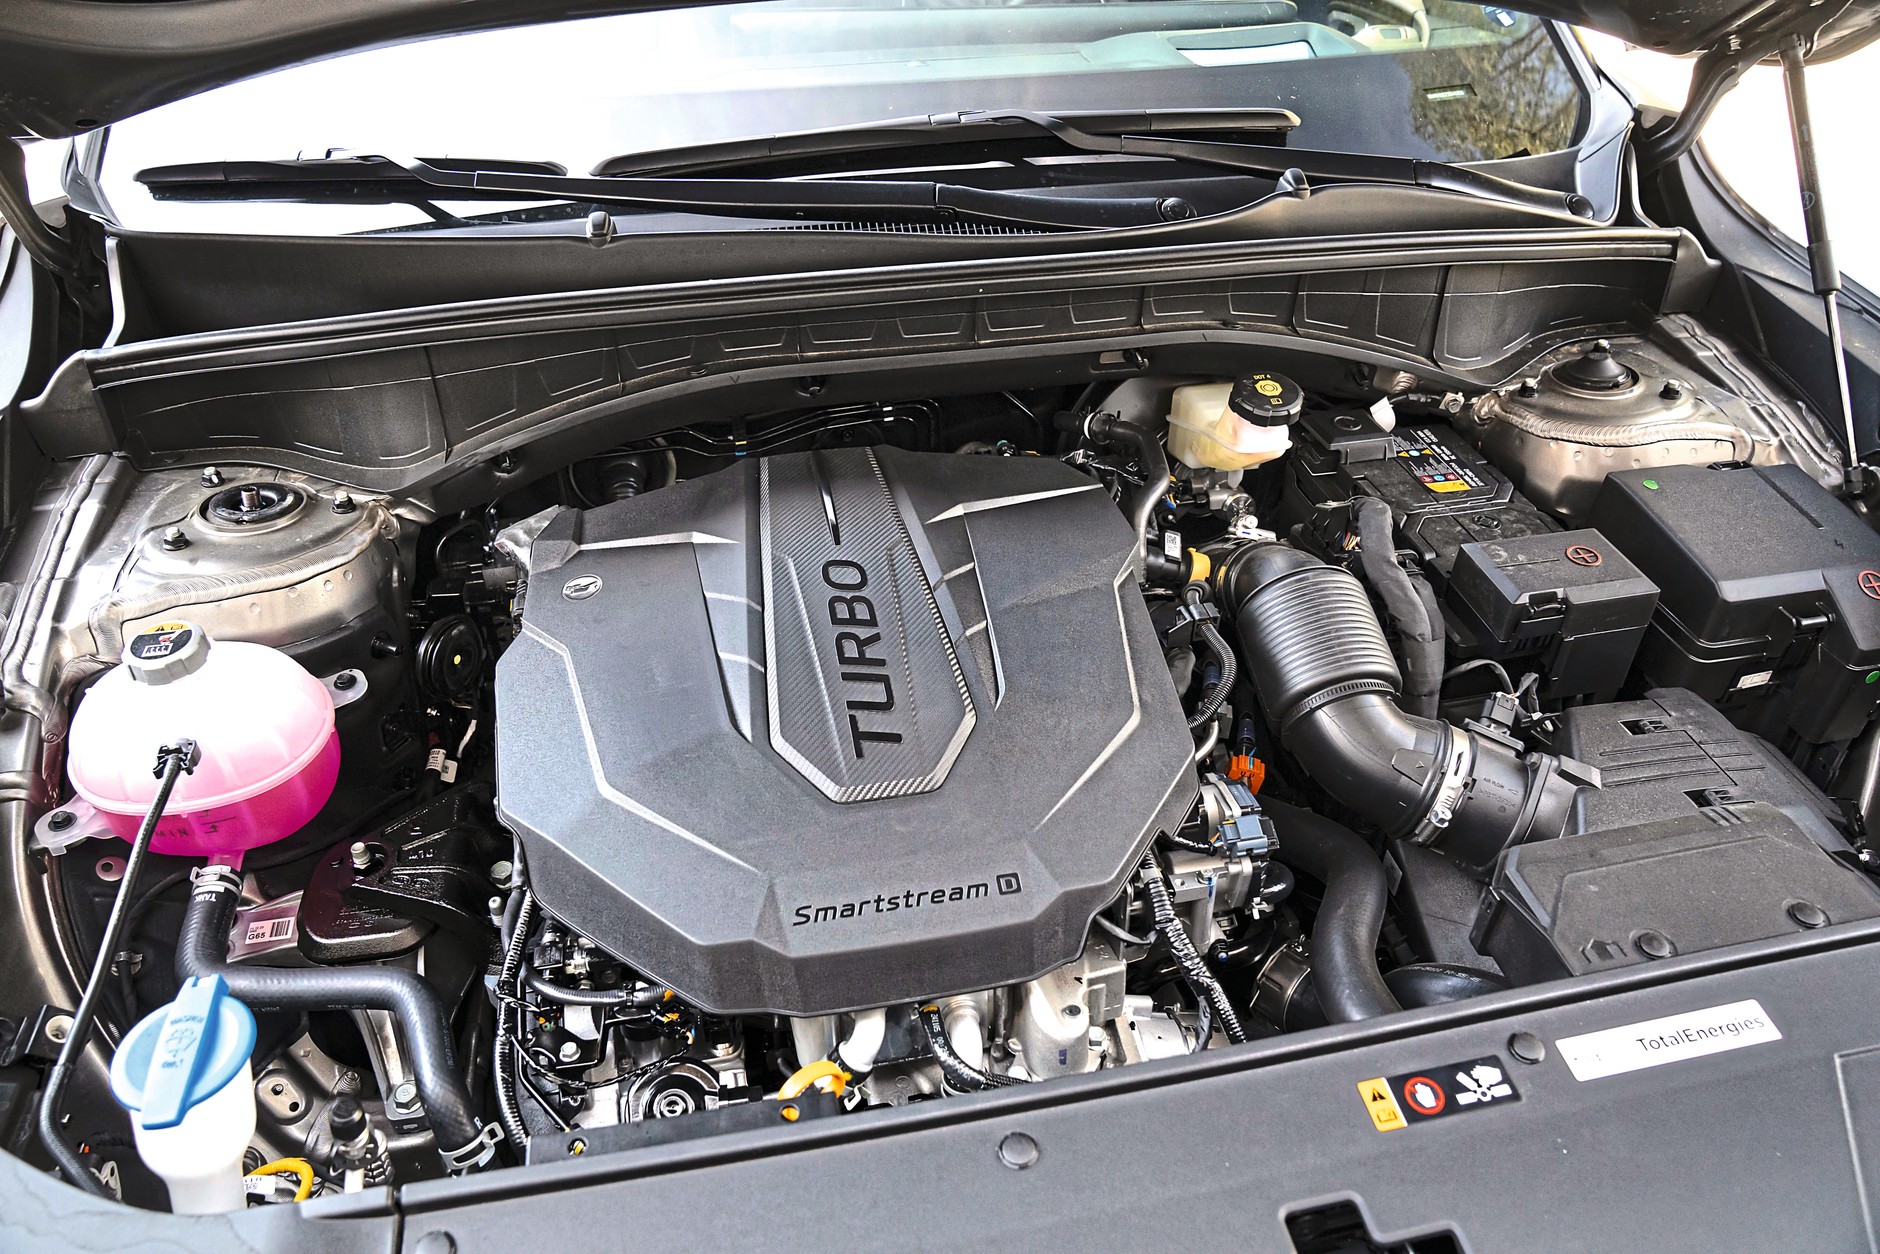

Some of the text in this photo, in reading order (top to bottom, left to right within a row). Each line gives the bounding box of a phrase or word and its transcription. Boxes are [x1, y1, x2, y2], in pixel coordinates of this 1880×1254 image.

[821, 559, 903, 759] TURBO
[194, 893, 217, 903] TANK
[792, 882, 989, 927] Smartstream
[247, 932, 266, 941] G65
[1636, 1015, 1765, 1052] TotalEnergies
